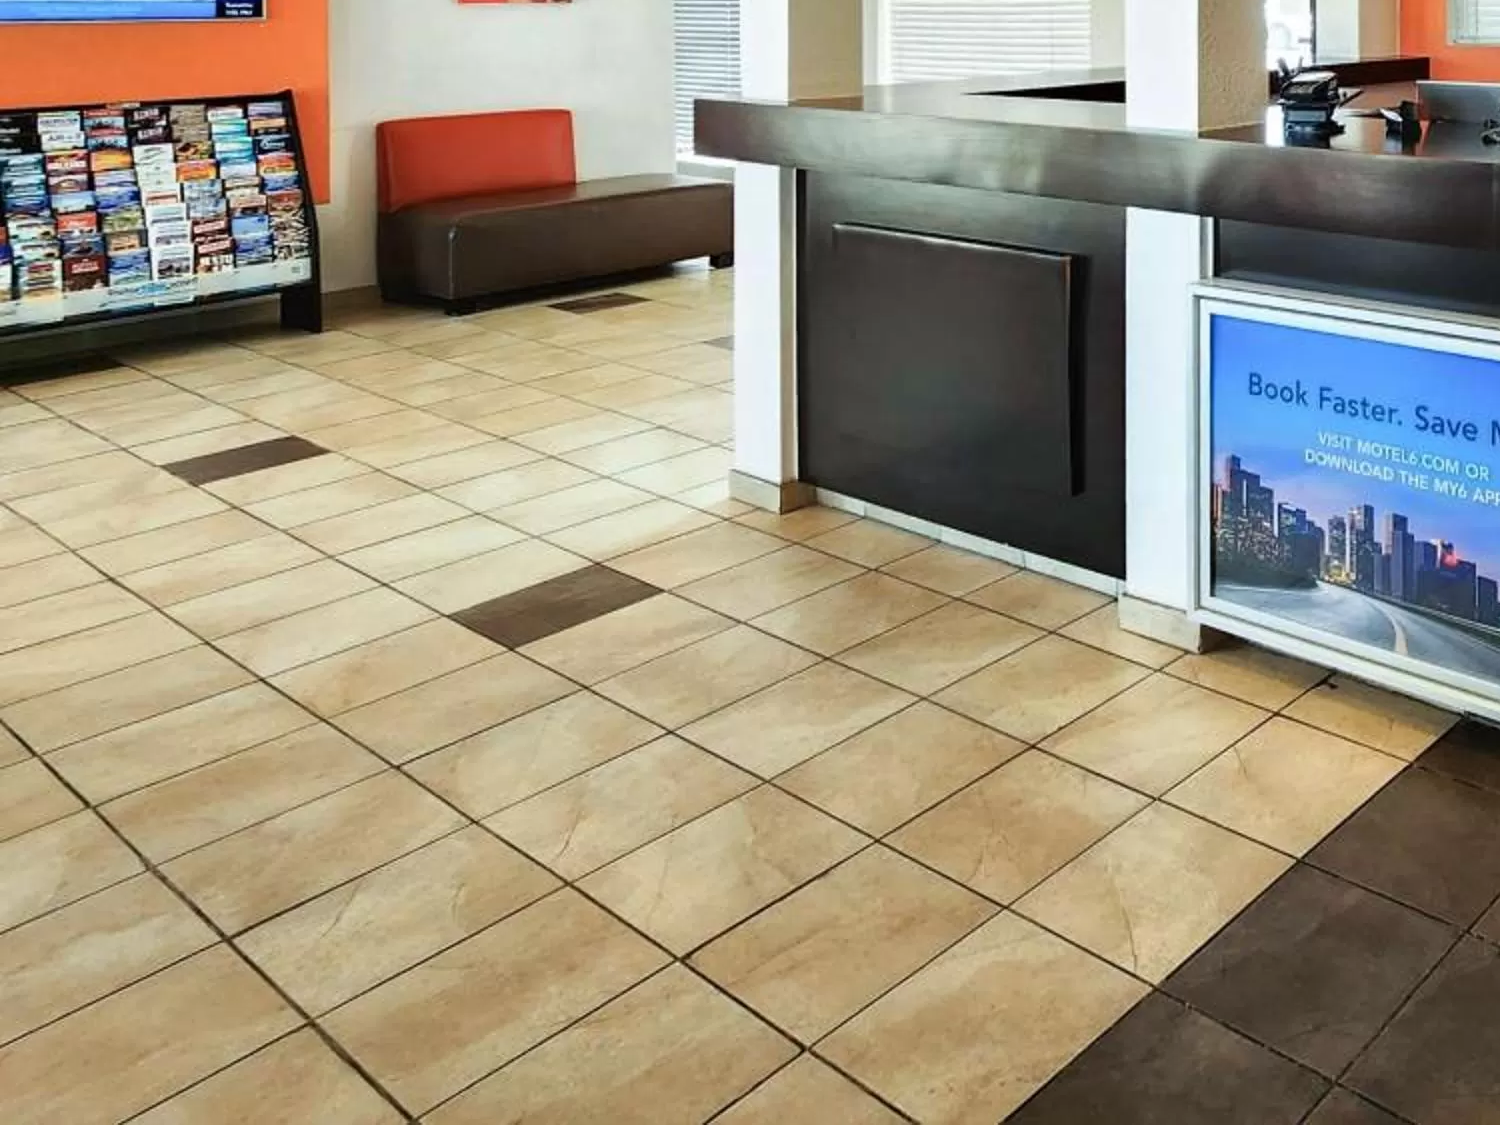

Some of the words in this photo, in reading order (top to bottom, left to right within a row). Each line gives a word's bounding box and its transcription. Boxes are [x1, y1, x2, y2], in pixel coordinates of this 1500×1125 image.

[1248, 372, 1309, 407] Book
[1319, 386, 1403, 426] Faster.
[1414, 405, 1479, 442] Save
[1304, 448, 1395, 481] DOWNLOAD
[1399, 470, 1429, 490] THE
[1433, 477, 1468, 500] MY6
[1318, 431, 1353, 451] VISIT
[1357, 438, 1460, 476] MOTEL6.COM
[1465, 462, 1490, 481] OR
